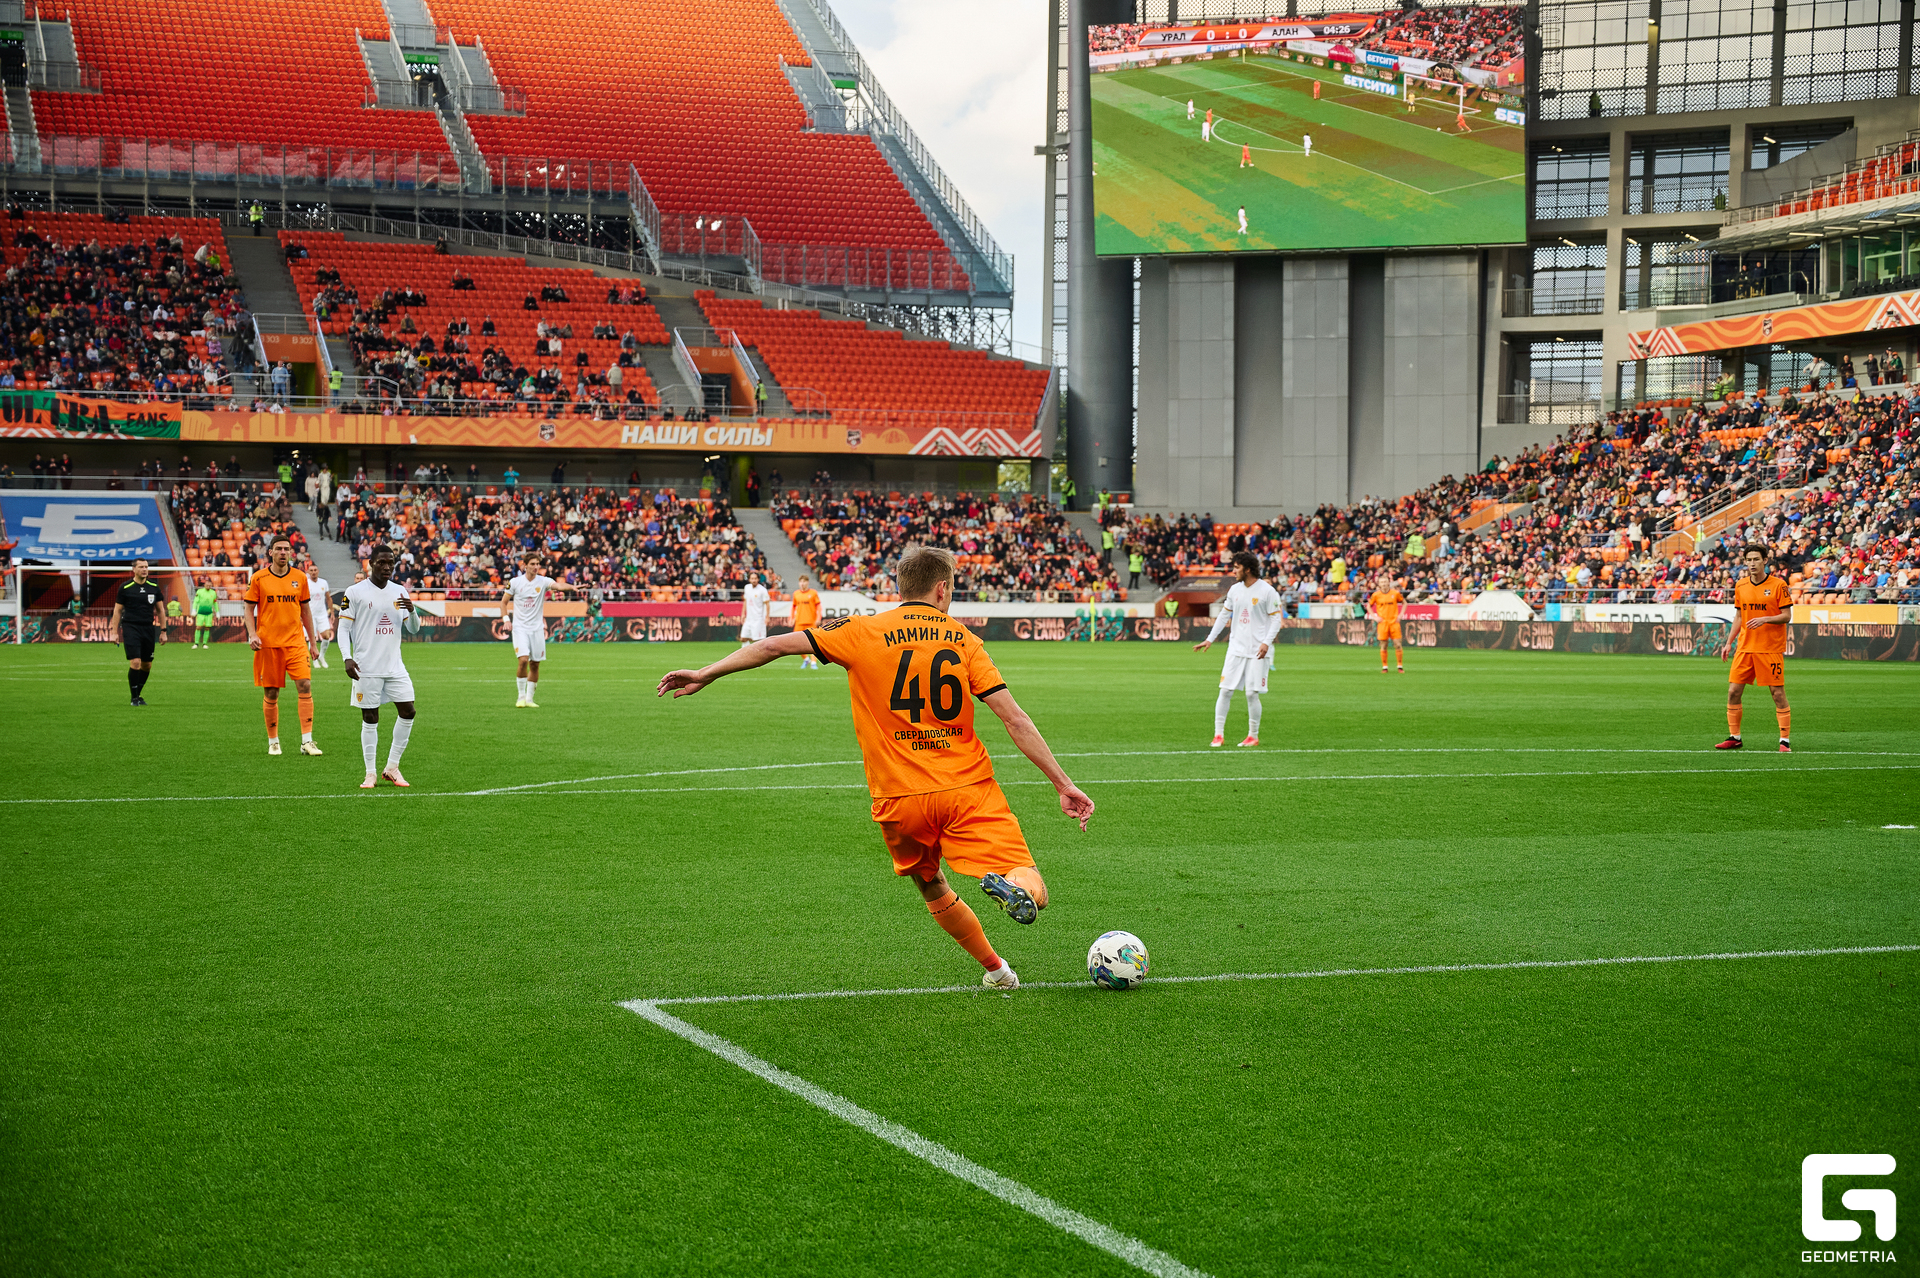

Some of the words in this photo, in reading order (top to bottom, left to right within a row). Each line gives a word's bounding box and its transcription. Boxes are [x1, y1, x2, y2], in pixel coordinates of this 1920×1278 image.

[1206, 30, 1215, 40] 0
[1238, 28, 1247, 39] 0
[1272, 28, 1299, 37] АЛАН
[1323, 25, 1351, 34] 04:26
[1161, 33, 1186, 41] УРАЛ
[1343, 74, 1396, 96] БЕТСИТИ
[266, 335, 280, 343] 303
[126, 412, 169, 428] FANS
[621, 425, 699, 445] НАШИ
[703, 426, 774, 447] СИЛЫ
[26, 545, 154, 558] БЕТСИТИ
[648, 617, 681, 629] SIMA
[903, 614, 947, 623] БЕТСИТИ
[1034, 618, 1065, 629] SIMA
[1152, 619, 1179, 630] SIMA
[648, 629, 682, 642] LAND
[1034, 629, 1066, 640] LAND
[1152, 629, 1180, 641] LAND
[1531, 622, 1553, 636] SIMA
[1667, 624, 1692, 639] SIMA
[883, 627, 939, 648] МАМИН
[943, 630, 965, 648] АР.
[1531, 635, 1554, 650] LAND
[1667, 638, 1693, 653] LAND
[1770, 662, 1782, 675] 75
[889, 649, 963, 723] 46
[894, 727, 964, 741] СВЕРДЛОВСКАЯ
[911, 739, 951, 751] ОБЛАСТЬ
